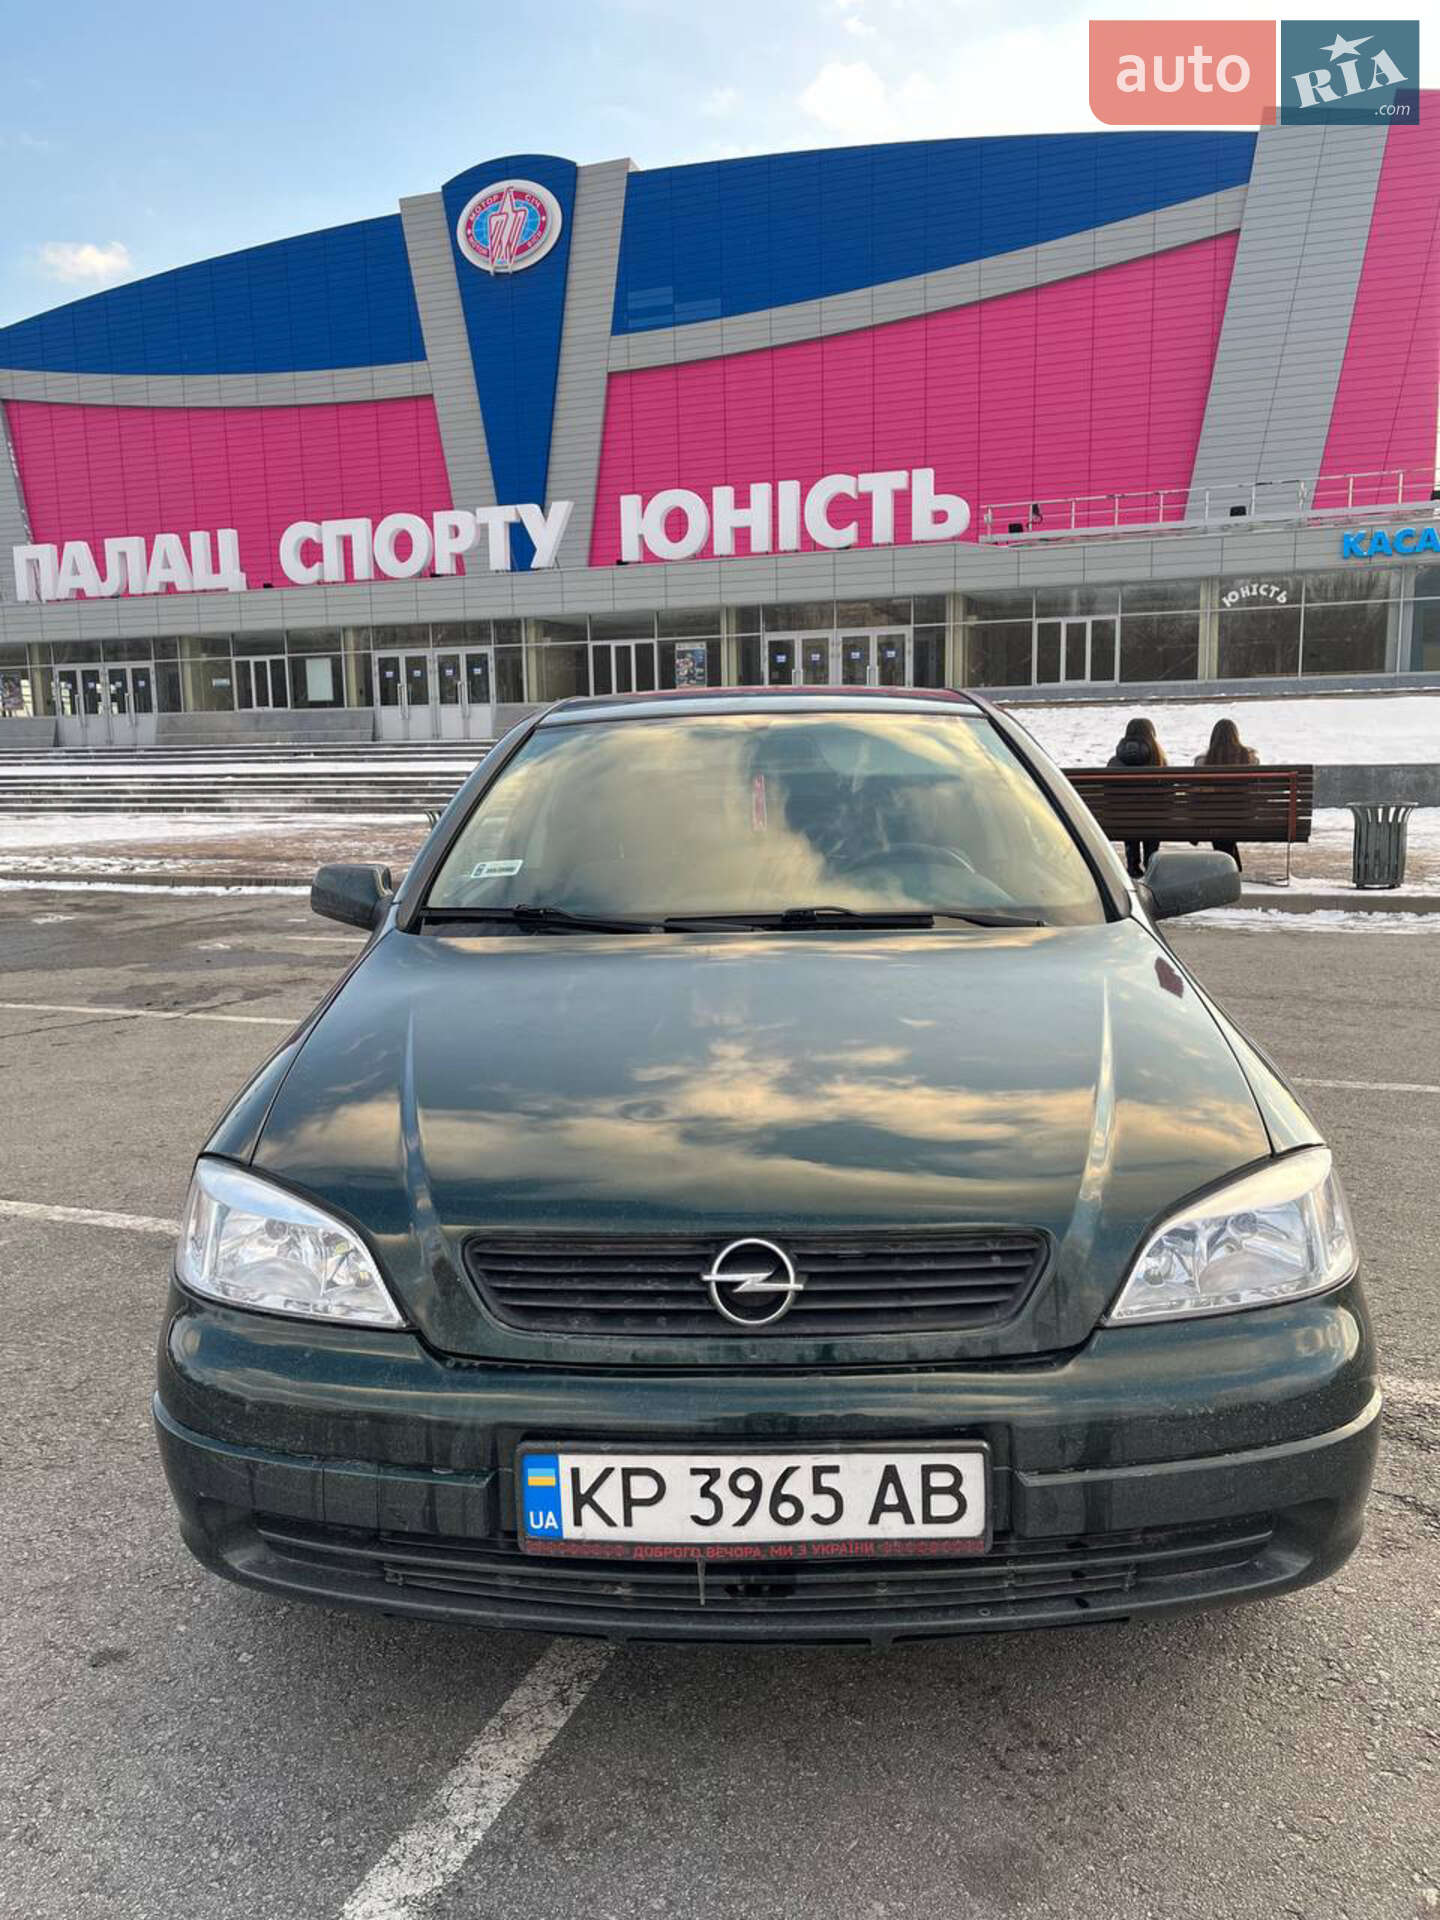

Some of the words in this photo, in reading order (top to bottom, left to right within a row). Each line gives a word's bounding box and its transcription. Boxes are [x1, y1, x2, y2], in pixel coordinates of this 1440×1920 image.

[13, 528, 247, 602] ПАЛАЦ
[279, 501, 573, 585] СПОРТУ
[619, 467, 971, 563] ЮНІСТЬ
[1221, 583, 1288, 608] ЮНІСТЬ
[570, 1466, 667, 1528] KP
[689, 1466, 844, 1528] 3965
[867, 1464, 968, 1525] AB
[529, 1512, 559, 1529] UA
[632, 1544, 702, 1561] ДОБРОГО
[769, 1547, 793, 1559] МИ
[812, 1539, 875, 1557] УКРАЇНИ
